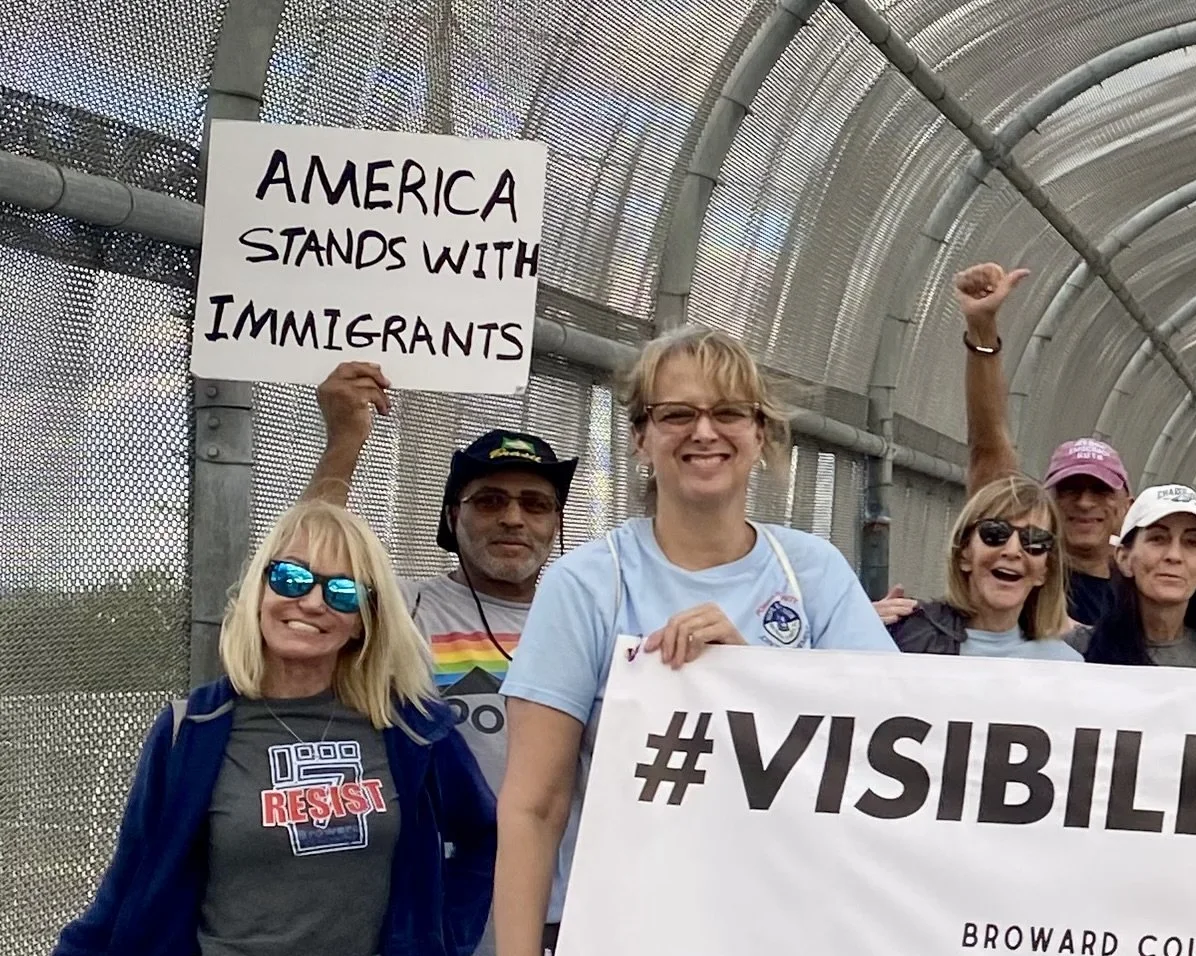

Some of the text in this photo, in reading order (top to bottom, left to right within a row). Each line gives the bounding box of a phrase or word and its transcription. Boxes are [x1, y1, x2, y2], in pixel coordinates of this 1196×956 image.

[256, 149, 518, 223] AMERICA
[238, 226, 540, 281] STANDS WITH
[204, 294, 525, 361] IMMIGRANTS
[262, 778, 387, 826] RESIST
[962, 923, 1119, 956] BROWARD
